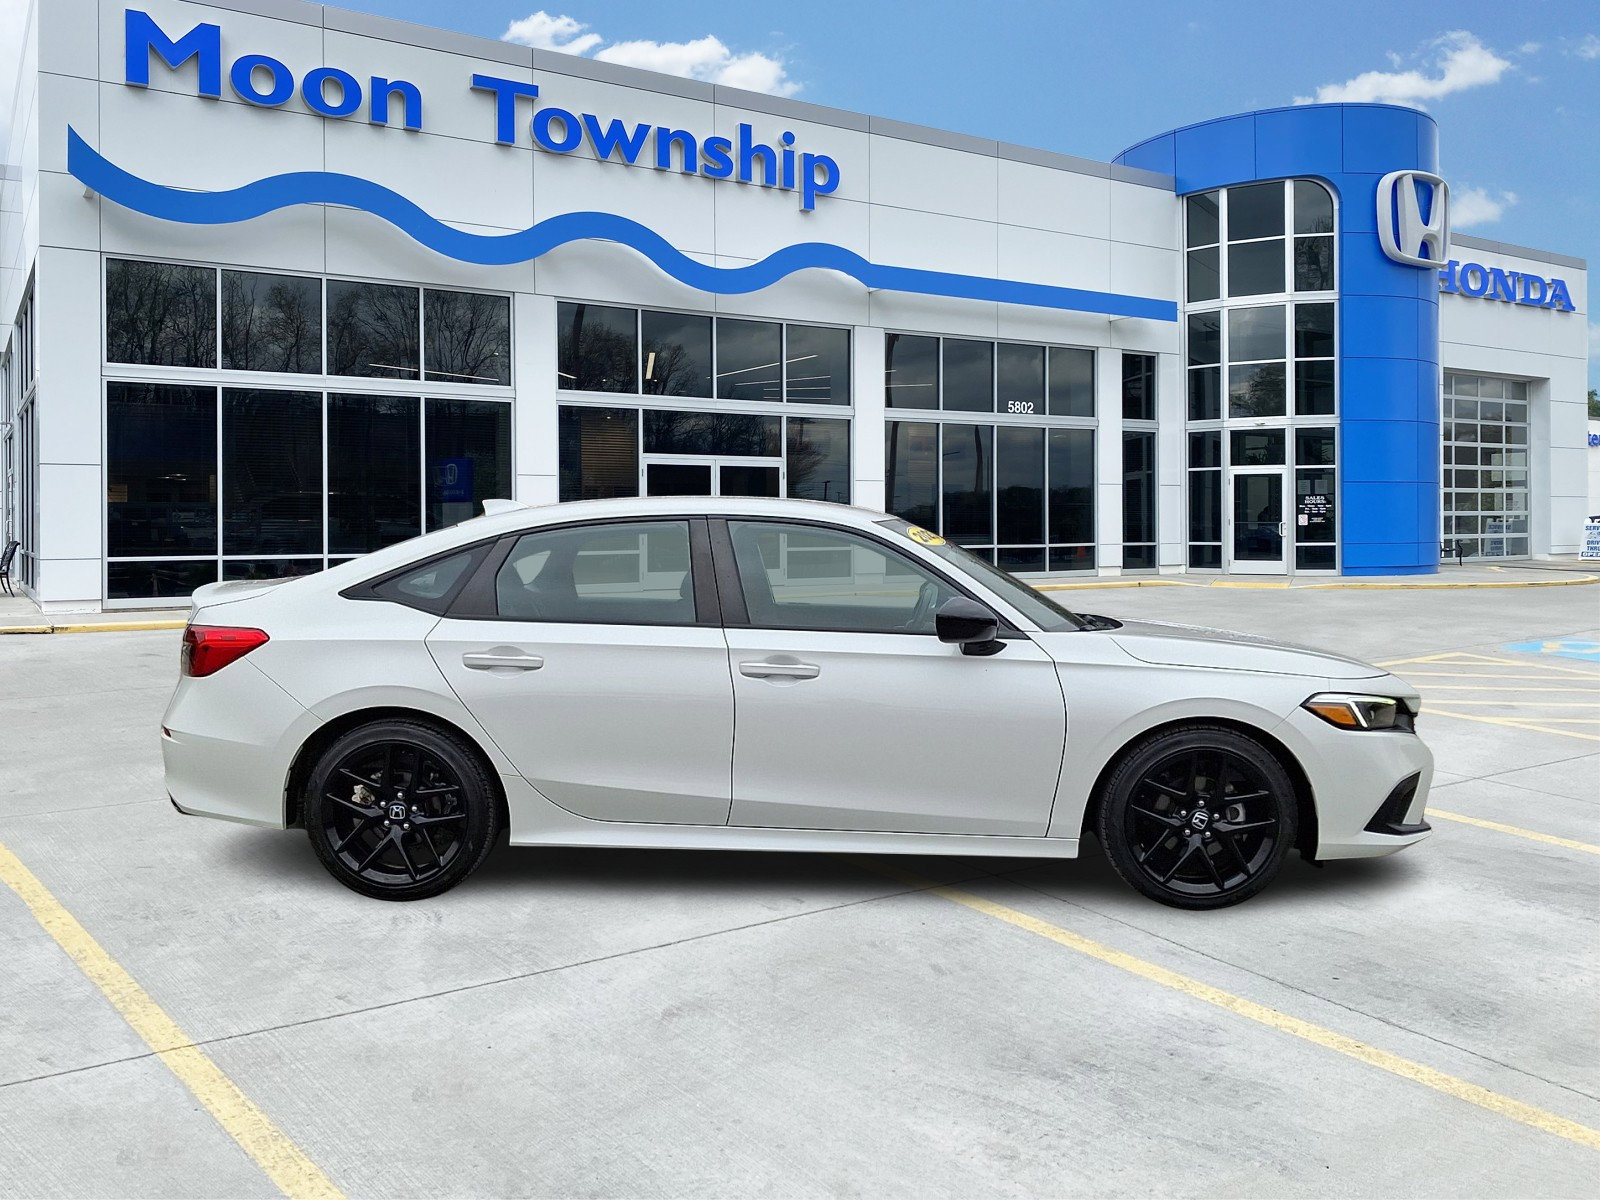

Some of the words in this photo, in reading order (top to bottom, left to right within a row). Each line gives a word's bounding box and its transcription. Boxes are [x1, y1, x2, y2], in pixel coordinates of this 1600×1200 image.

[125, 9, 422, 131] Moon
[471, 74, 841, 212] Township
[1438, 260, 1576, 312] HONDA
[1008, 400, 1034, 414] 5802
